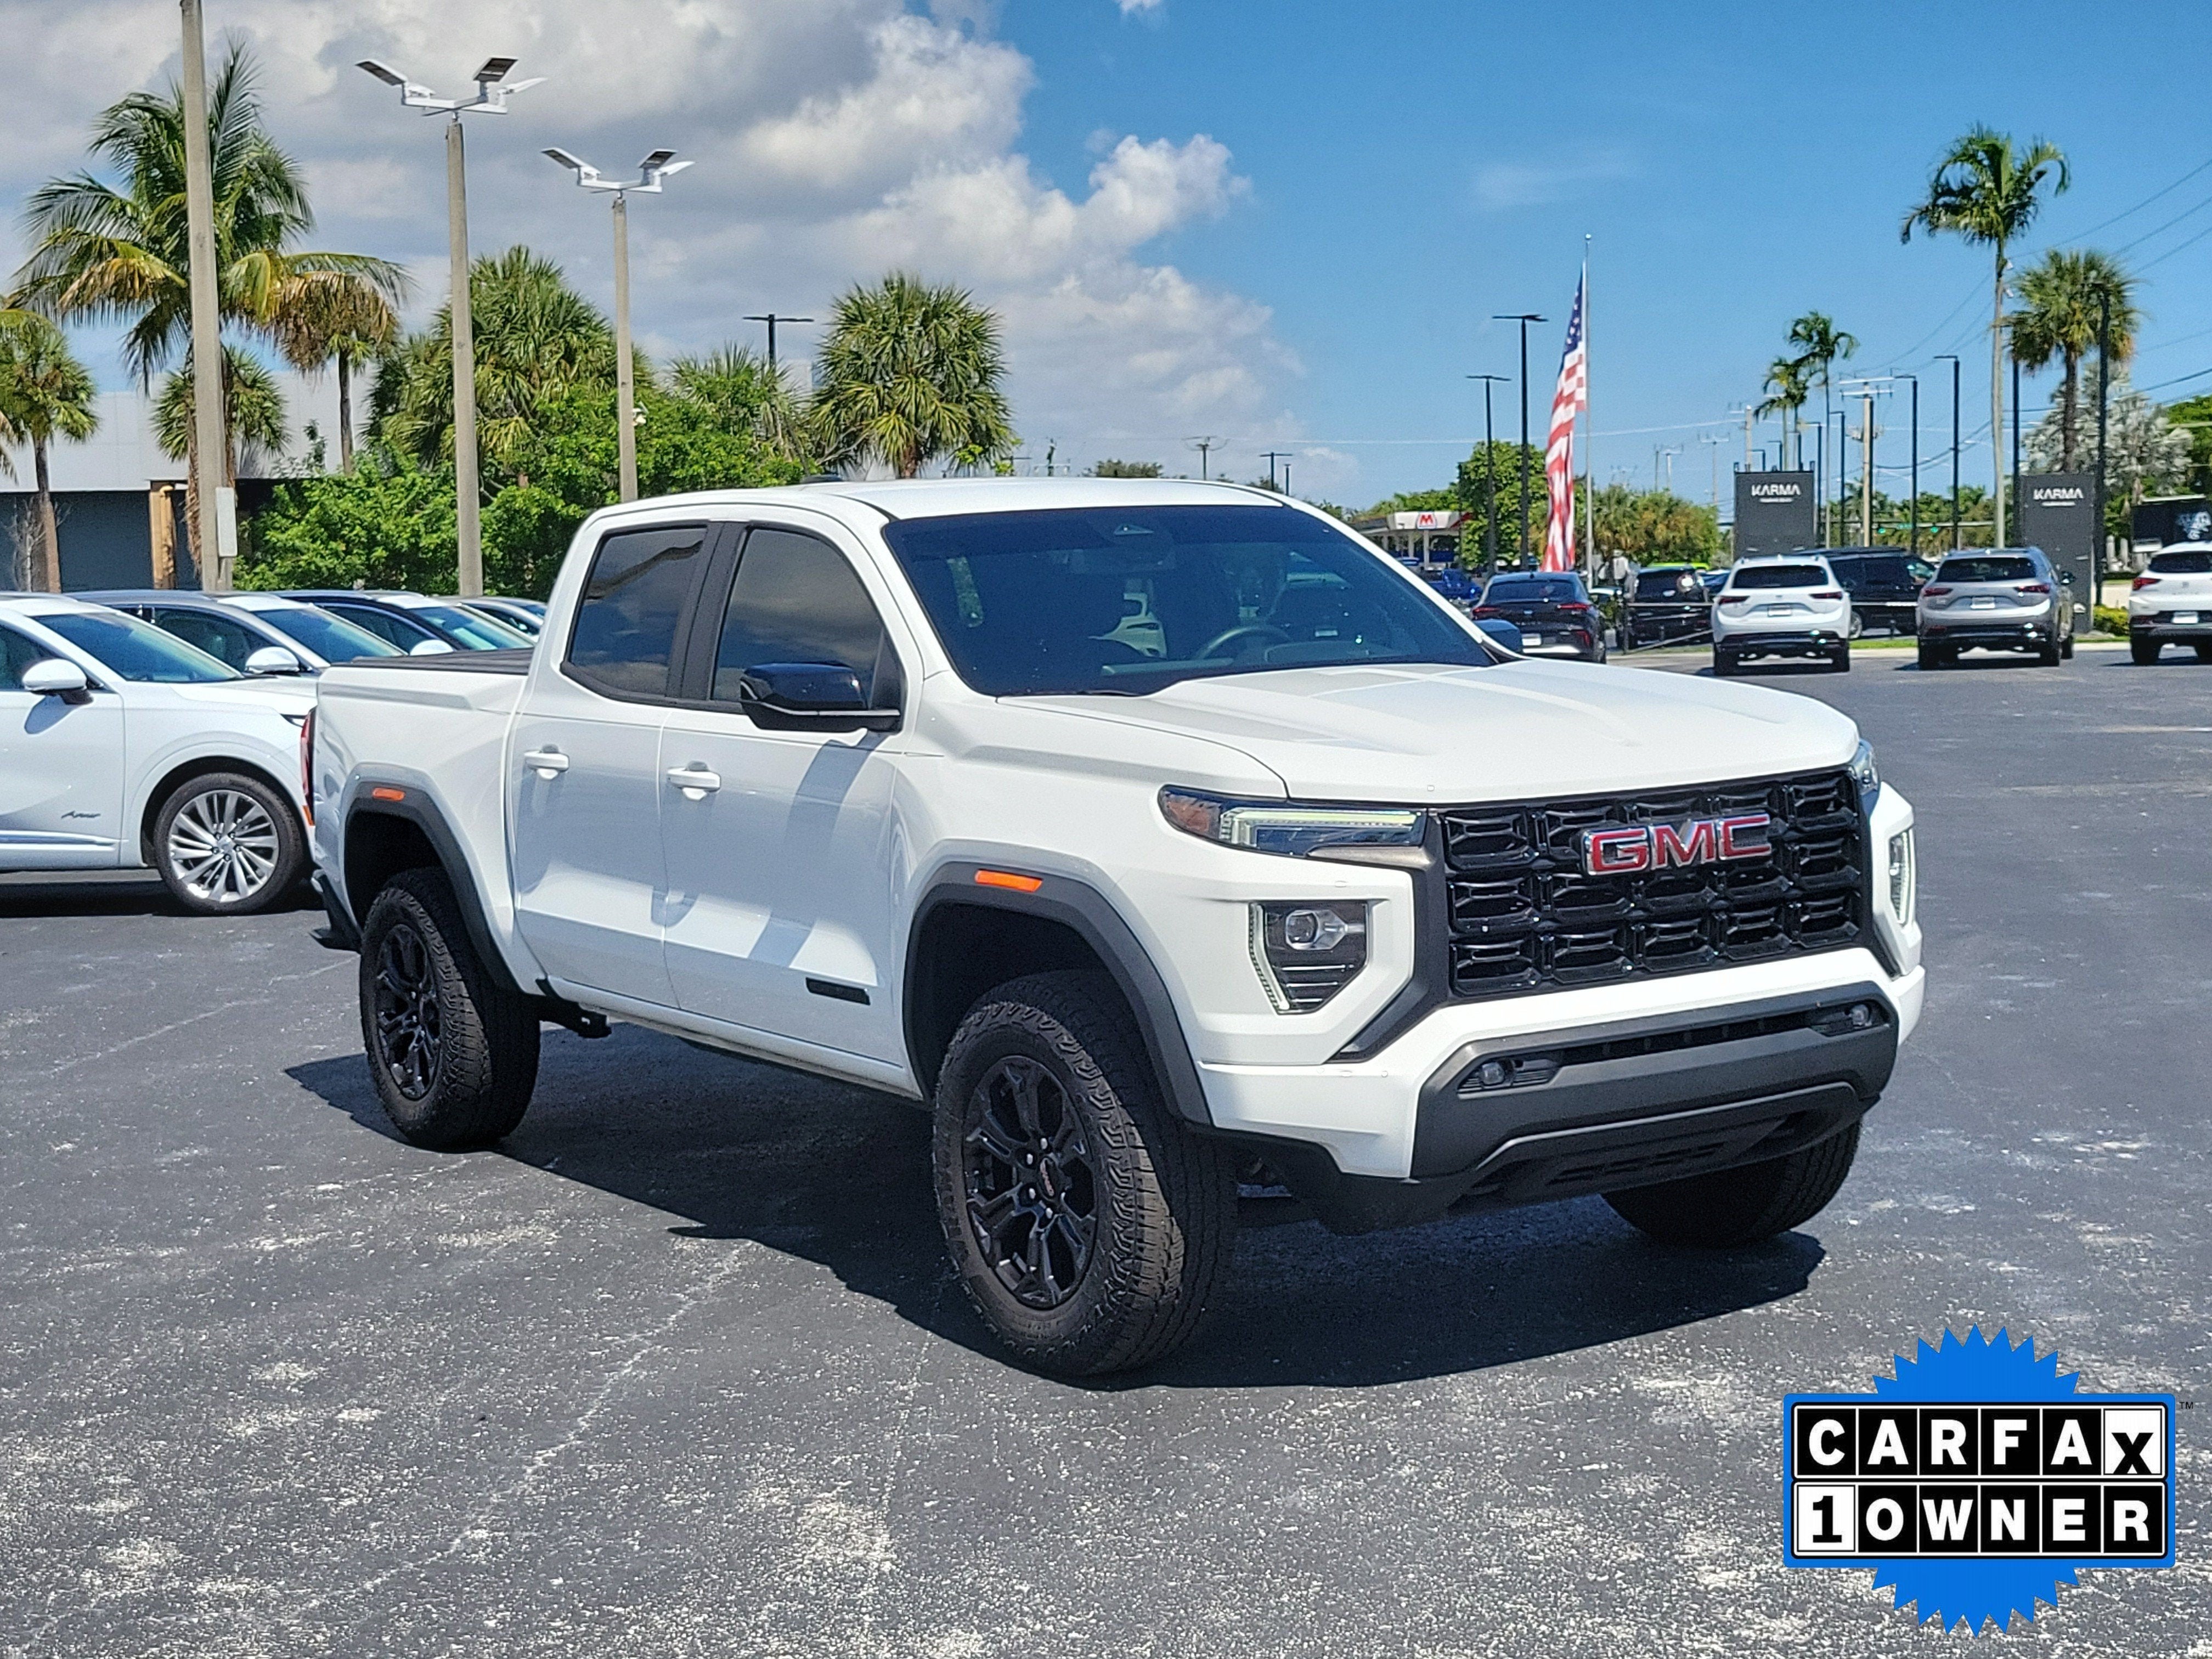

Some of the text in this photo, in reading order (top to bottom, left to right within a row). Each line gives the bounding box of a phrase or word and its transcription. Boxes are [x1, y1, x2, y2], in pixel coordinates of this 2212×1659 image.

[1751, 484, 1801, 495] KARMA
[2033, 488, 2084, 499] KARMA
[1420, 515, 1434, 524] M
[1584, 814, 1772, 875] GMC
